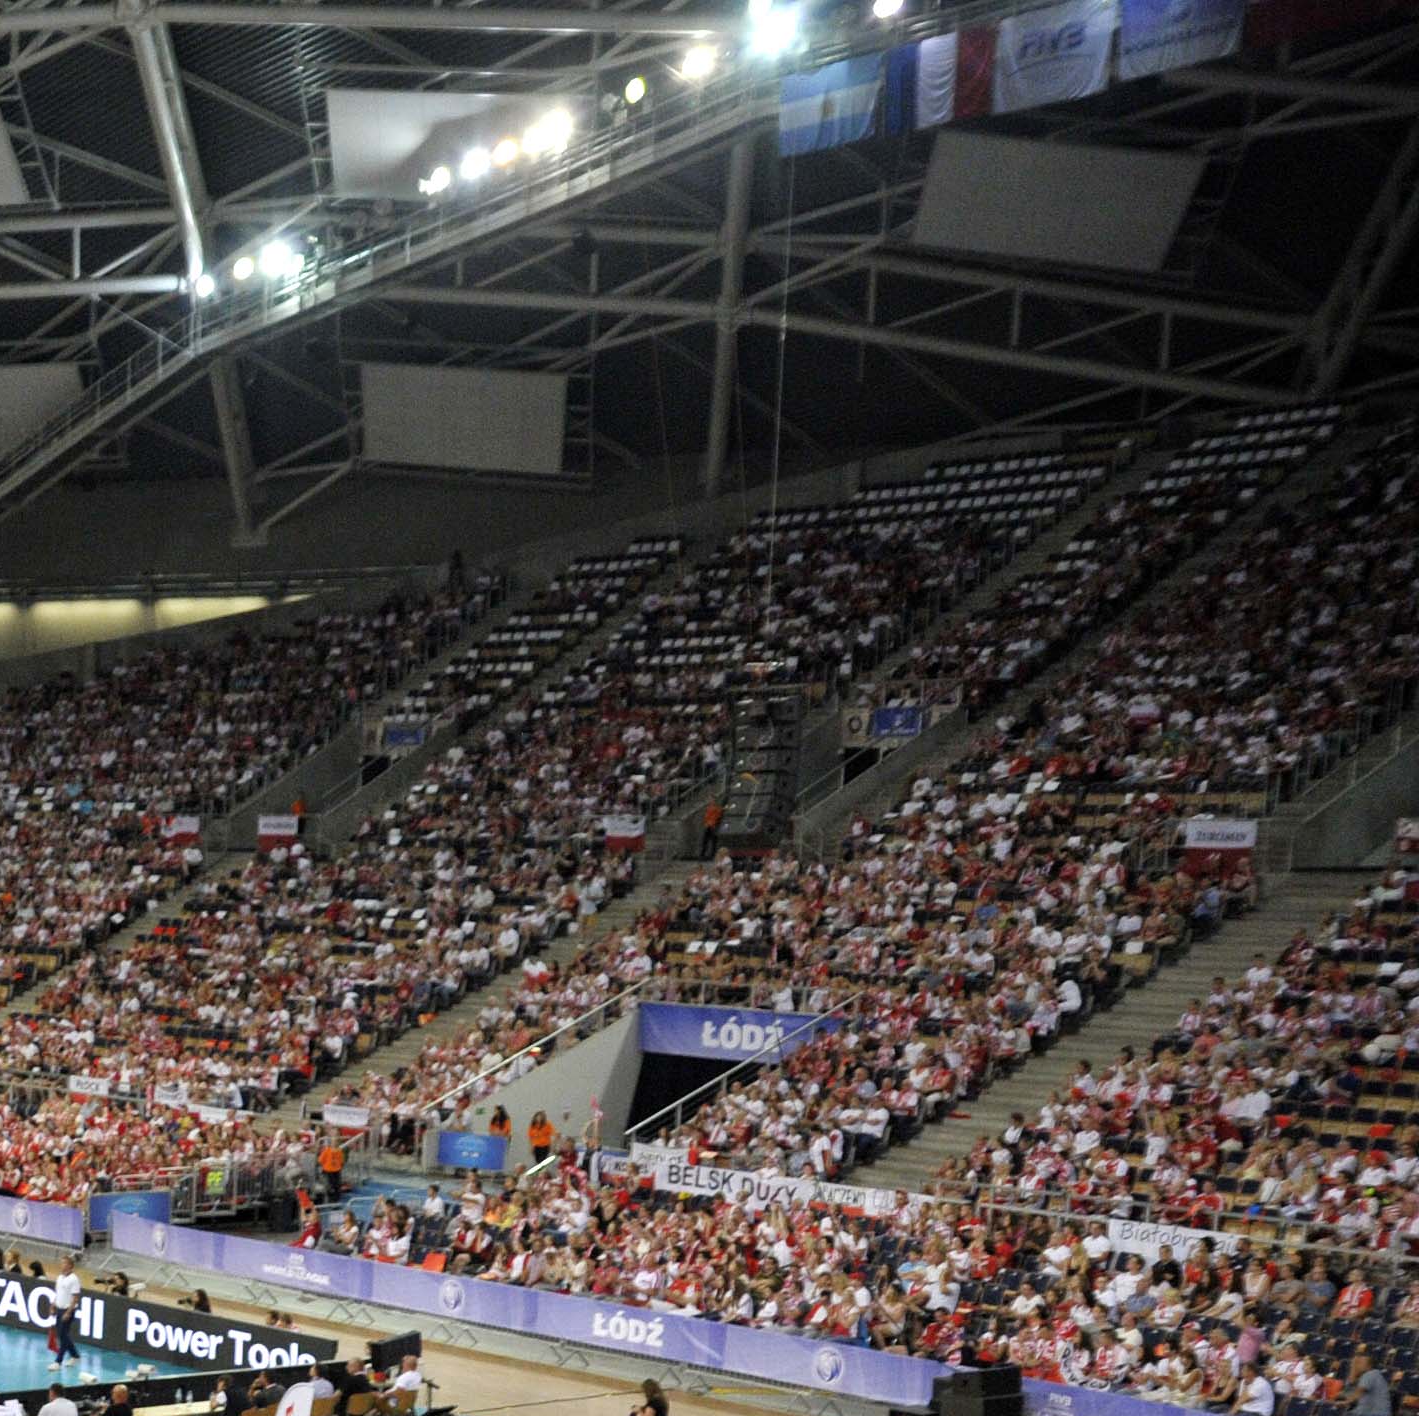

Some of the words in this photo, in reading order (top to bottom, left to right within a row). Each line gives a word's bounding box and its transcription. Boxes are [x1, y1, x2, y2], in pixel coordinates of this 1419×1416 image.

[701, 1016, 784, 1053] ŁÓDŹ
[668, 1164, 735, 1192] BELSK
[126, 1308, 224, 1361] Power
[592, 1309, 664, 1349] ŁÓDŹ
